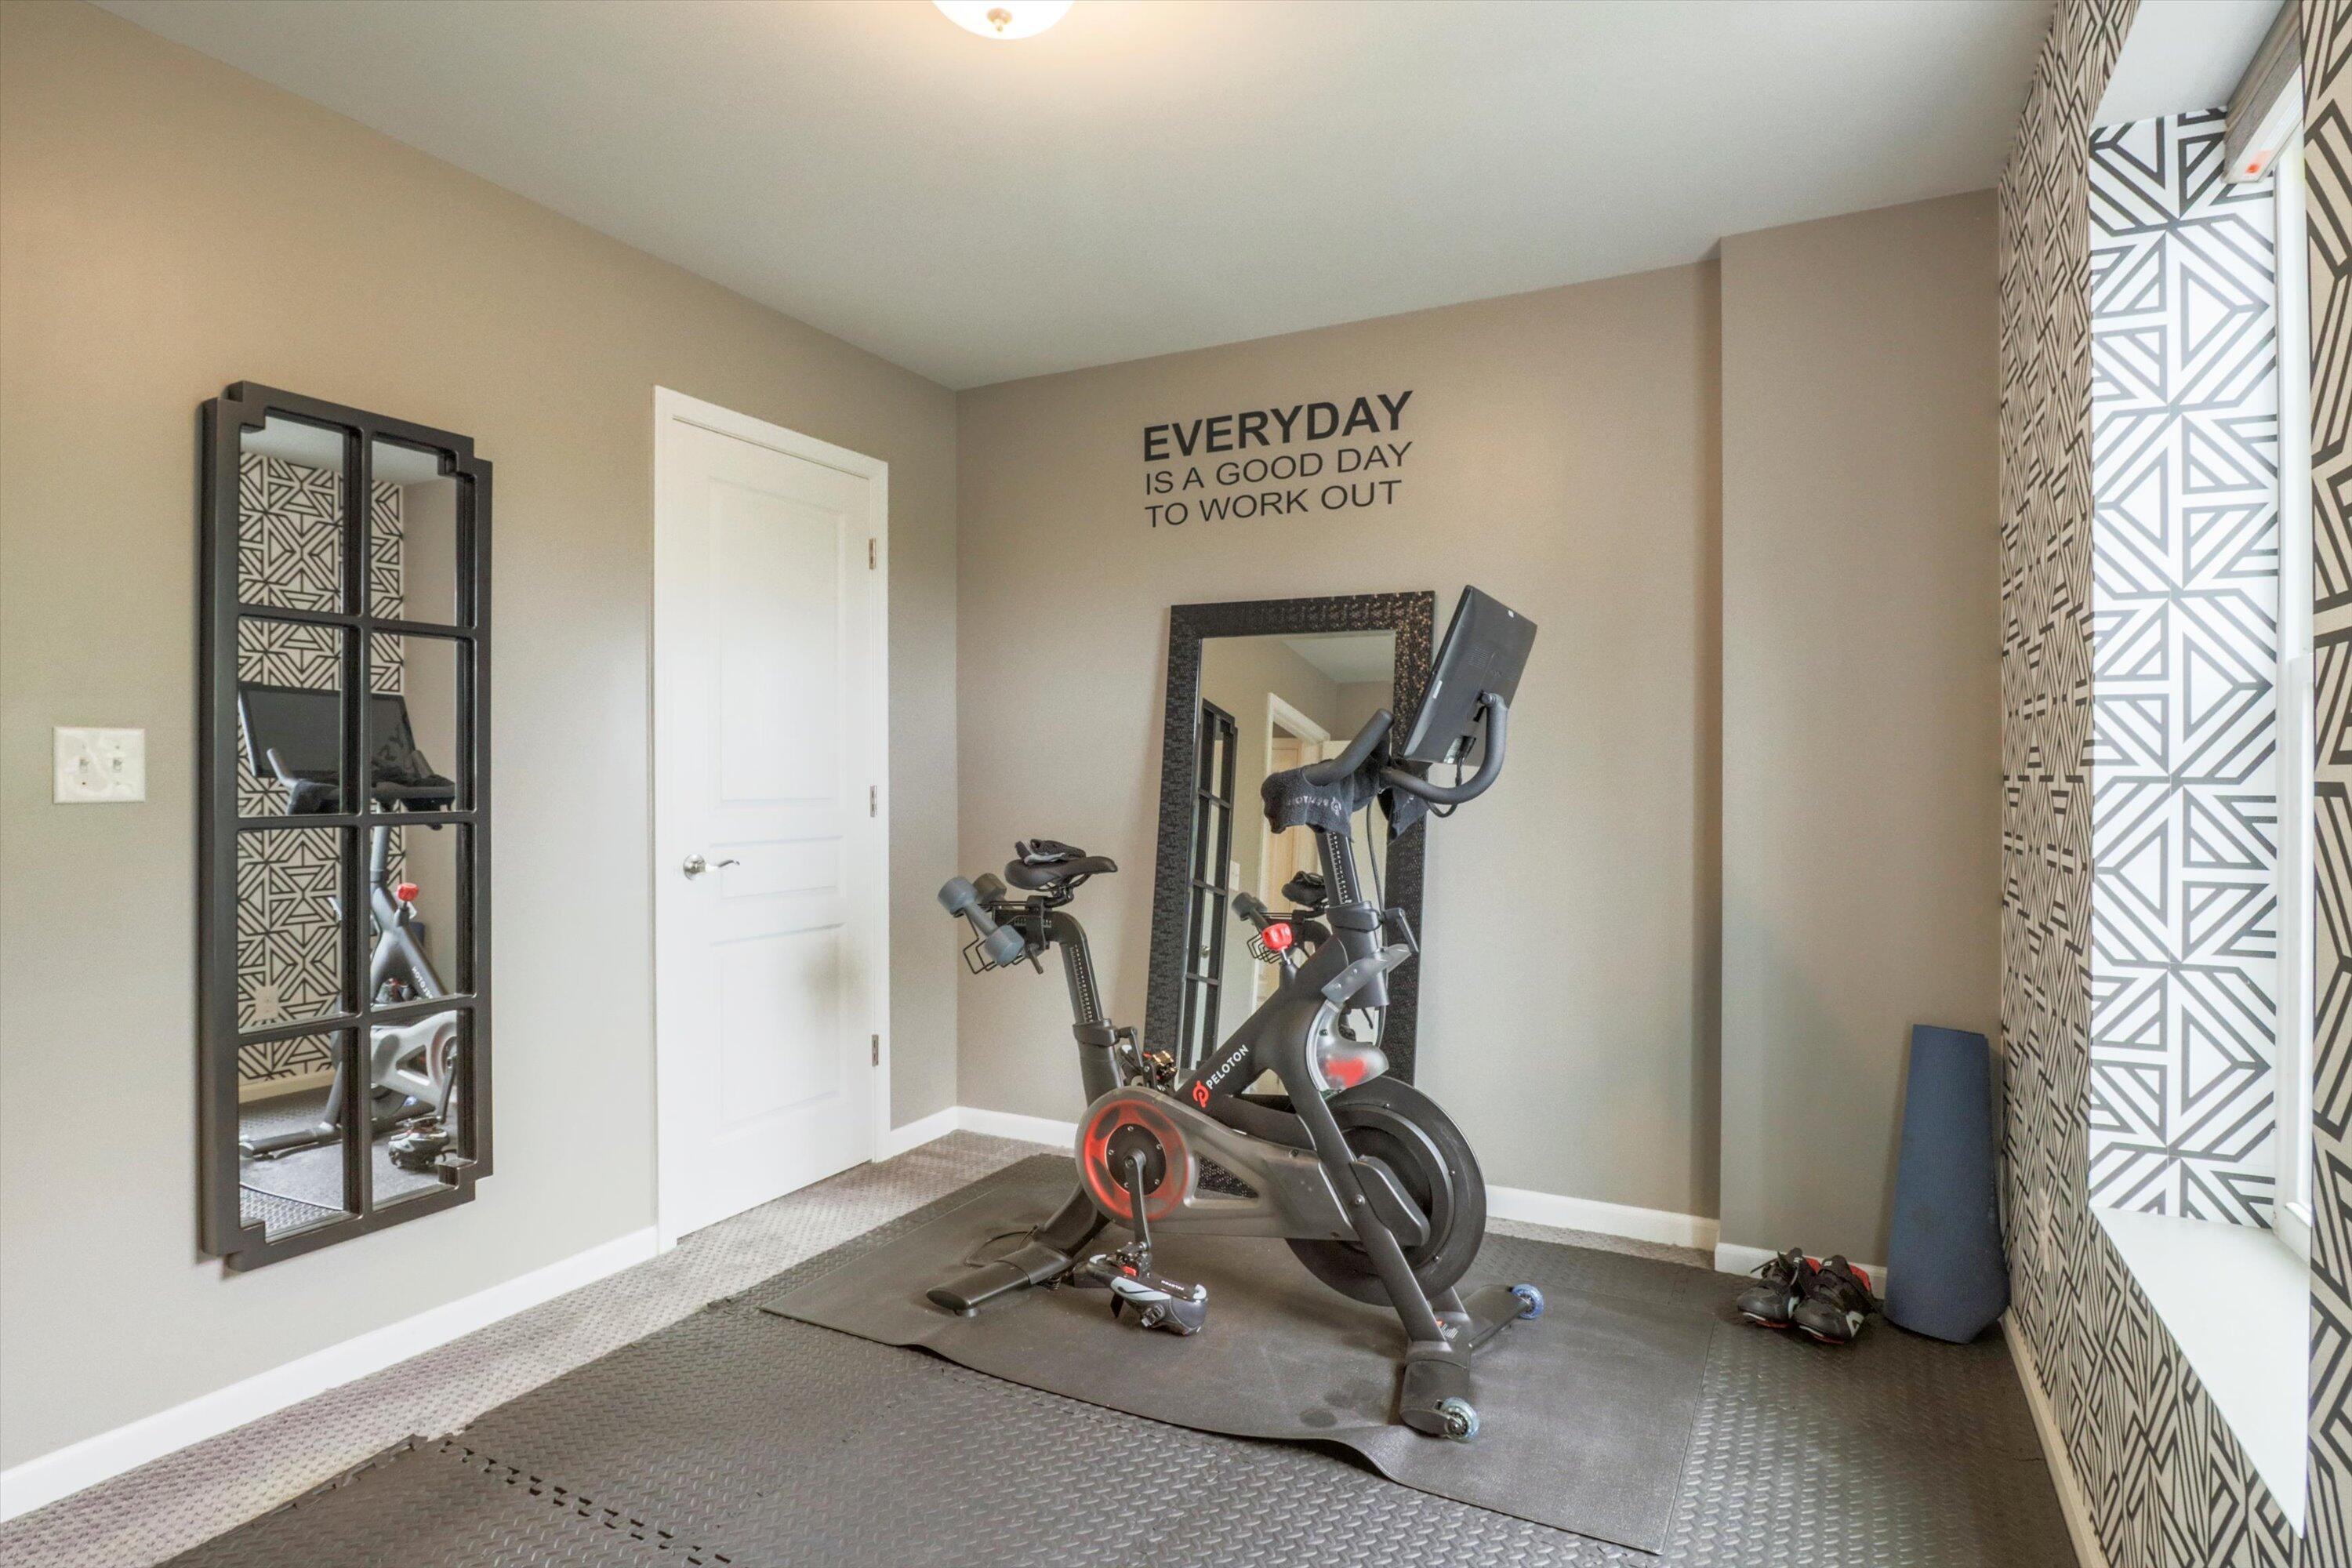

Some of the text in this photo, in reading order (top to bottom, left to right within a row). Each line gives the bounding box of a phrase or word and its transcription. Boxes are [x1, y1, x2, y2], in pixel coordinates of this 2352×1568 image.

[1144, 390, 1414, 463] EVERYDAY
[1146, 441, 1413, 495] IS A GOOD DAY
[1144, 480, 1402, 528] TO WORK OUT
[1206, 1044, 1250, 1090] PELOTON
